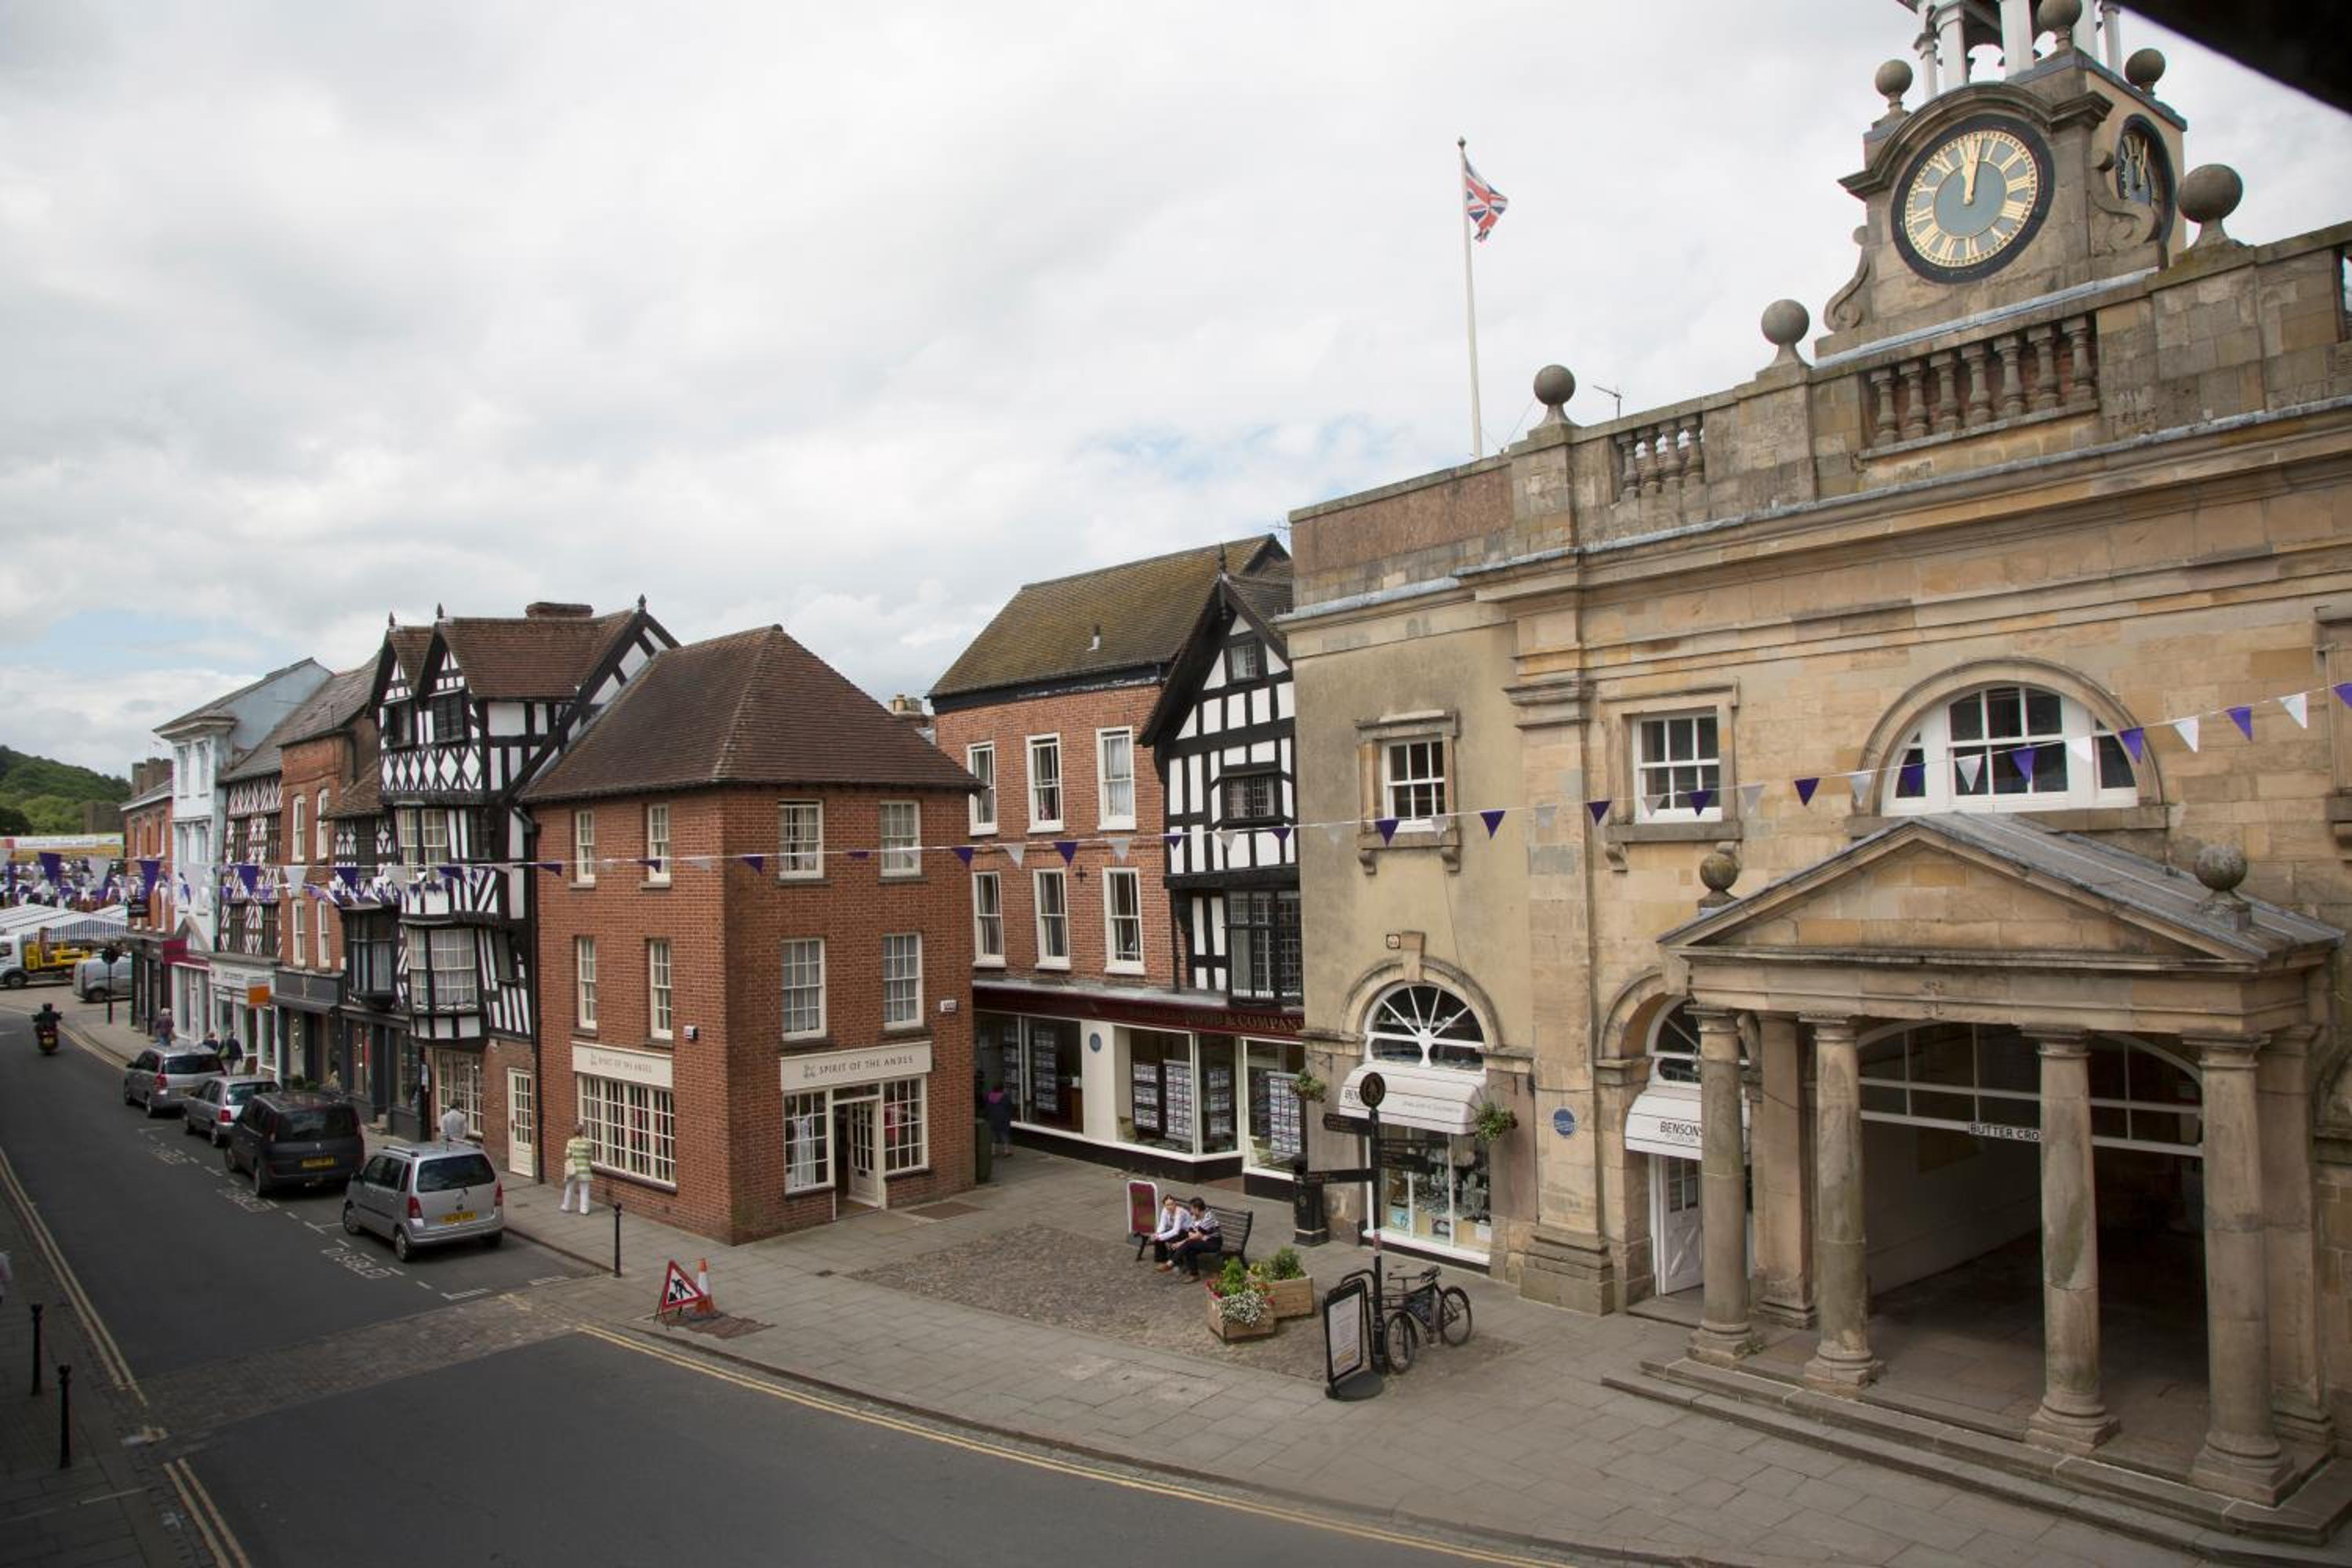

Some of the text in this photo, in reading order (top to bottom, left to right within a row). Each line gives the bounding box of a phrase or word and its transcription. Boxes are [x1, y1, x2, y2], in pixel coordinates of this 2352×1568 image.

[819, 1055, 913, 1075] SPIRIT OF THE ANDES
[1345, 1089, 1360, 1102] BEN
[1970, 1123, 2039, 1141] BUTTER CRO
